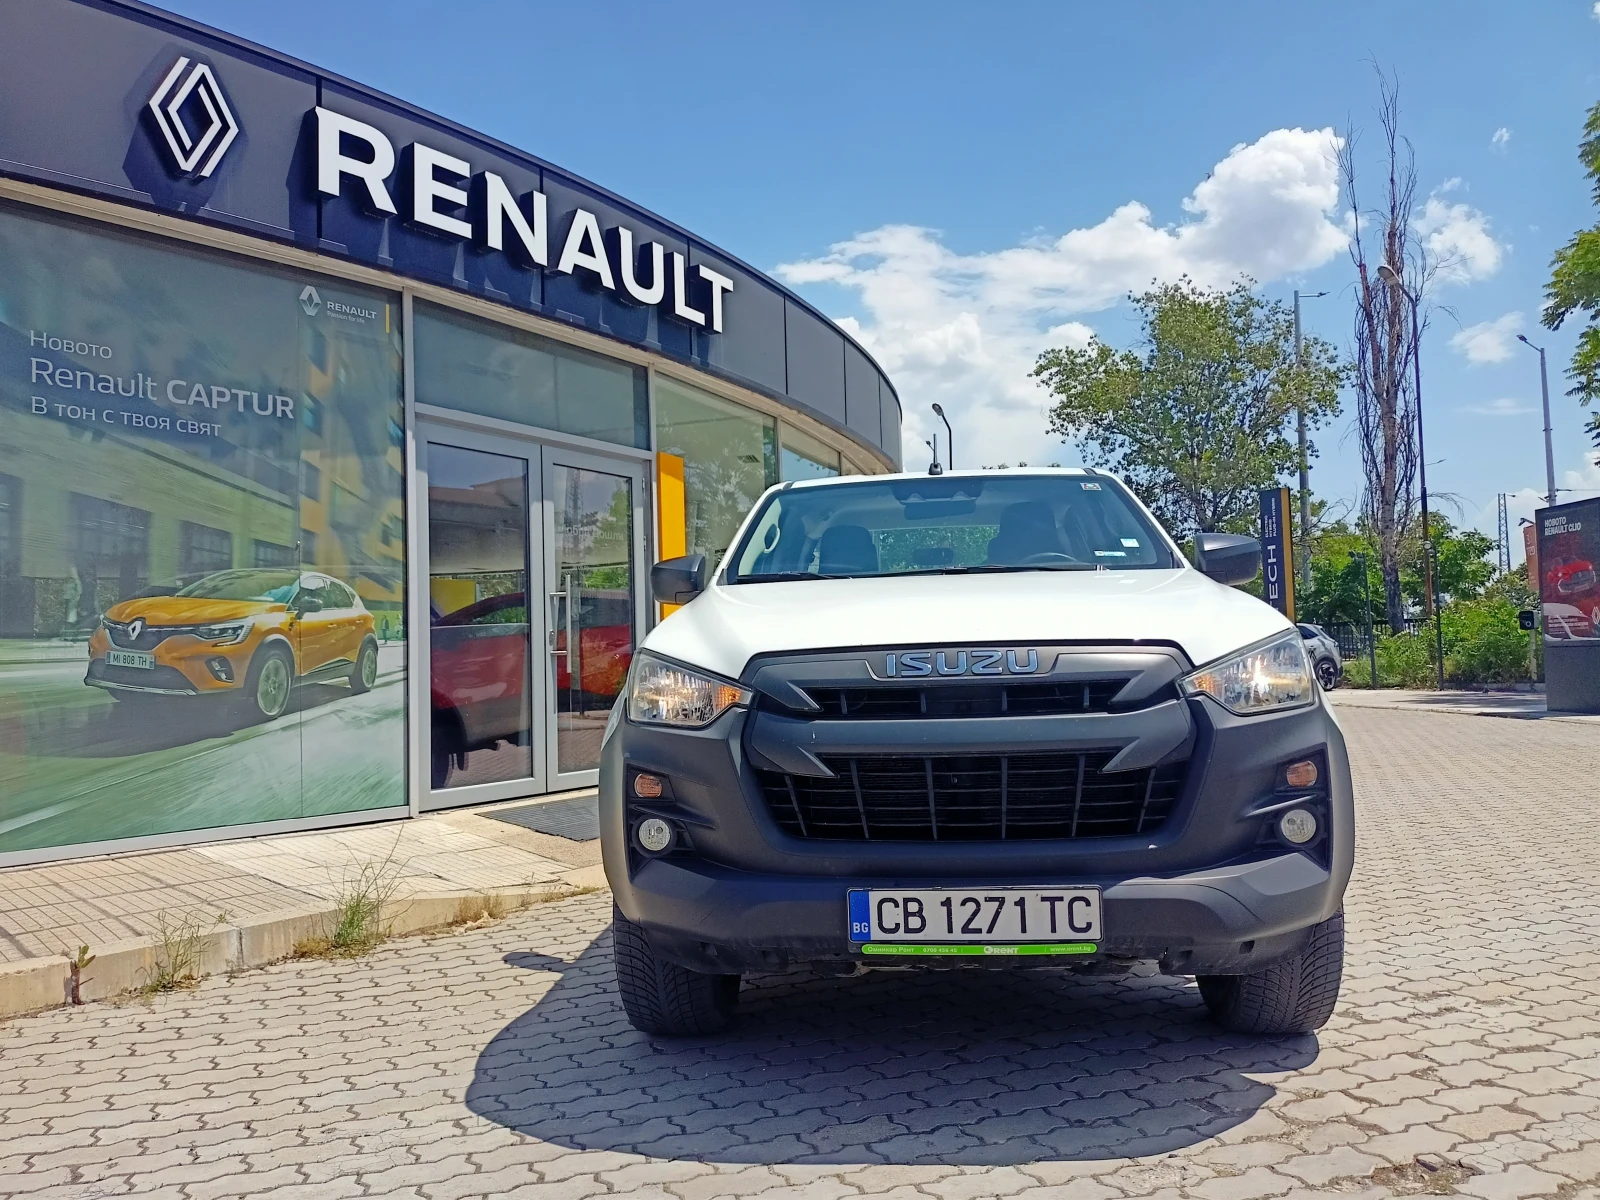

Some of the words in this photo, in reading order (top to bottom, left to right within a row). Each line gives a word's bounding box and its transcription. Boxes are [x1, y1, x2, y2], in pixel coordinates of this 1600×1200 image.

[315, 106, 734, 334] RENAULT
[326, 301, 377, 319] RENAULT
[327, 310, 348, 320] Passion
[30, 357, 158, 401] Renault
[166, 380, 295, 420] CAPTUR
[31, 396, 48, 415] В
[1544, 525, 1568, 536] RENAULT
[1568, 522, 1581, 532] CLIO
[113, 653, 121, 663] MI
[122, 654, 135, 665] 808
[138, 656, 147, 666] TH
[885, 649, 1039, 678] ISUZU
[876, 896, 927, 934] CB
[940, 895, 1028, 935] 1271
[1040, 895, 1093, 934] TC
[853, 922, 869, 934] BG
